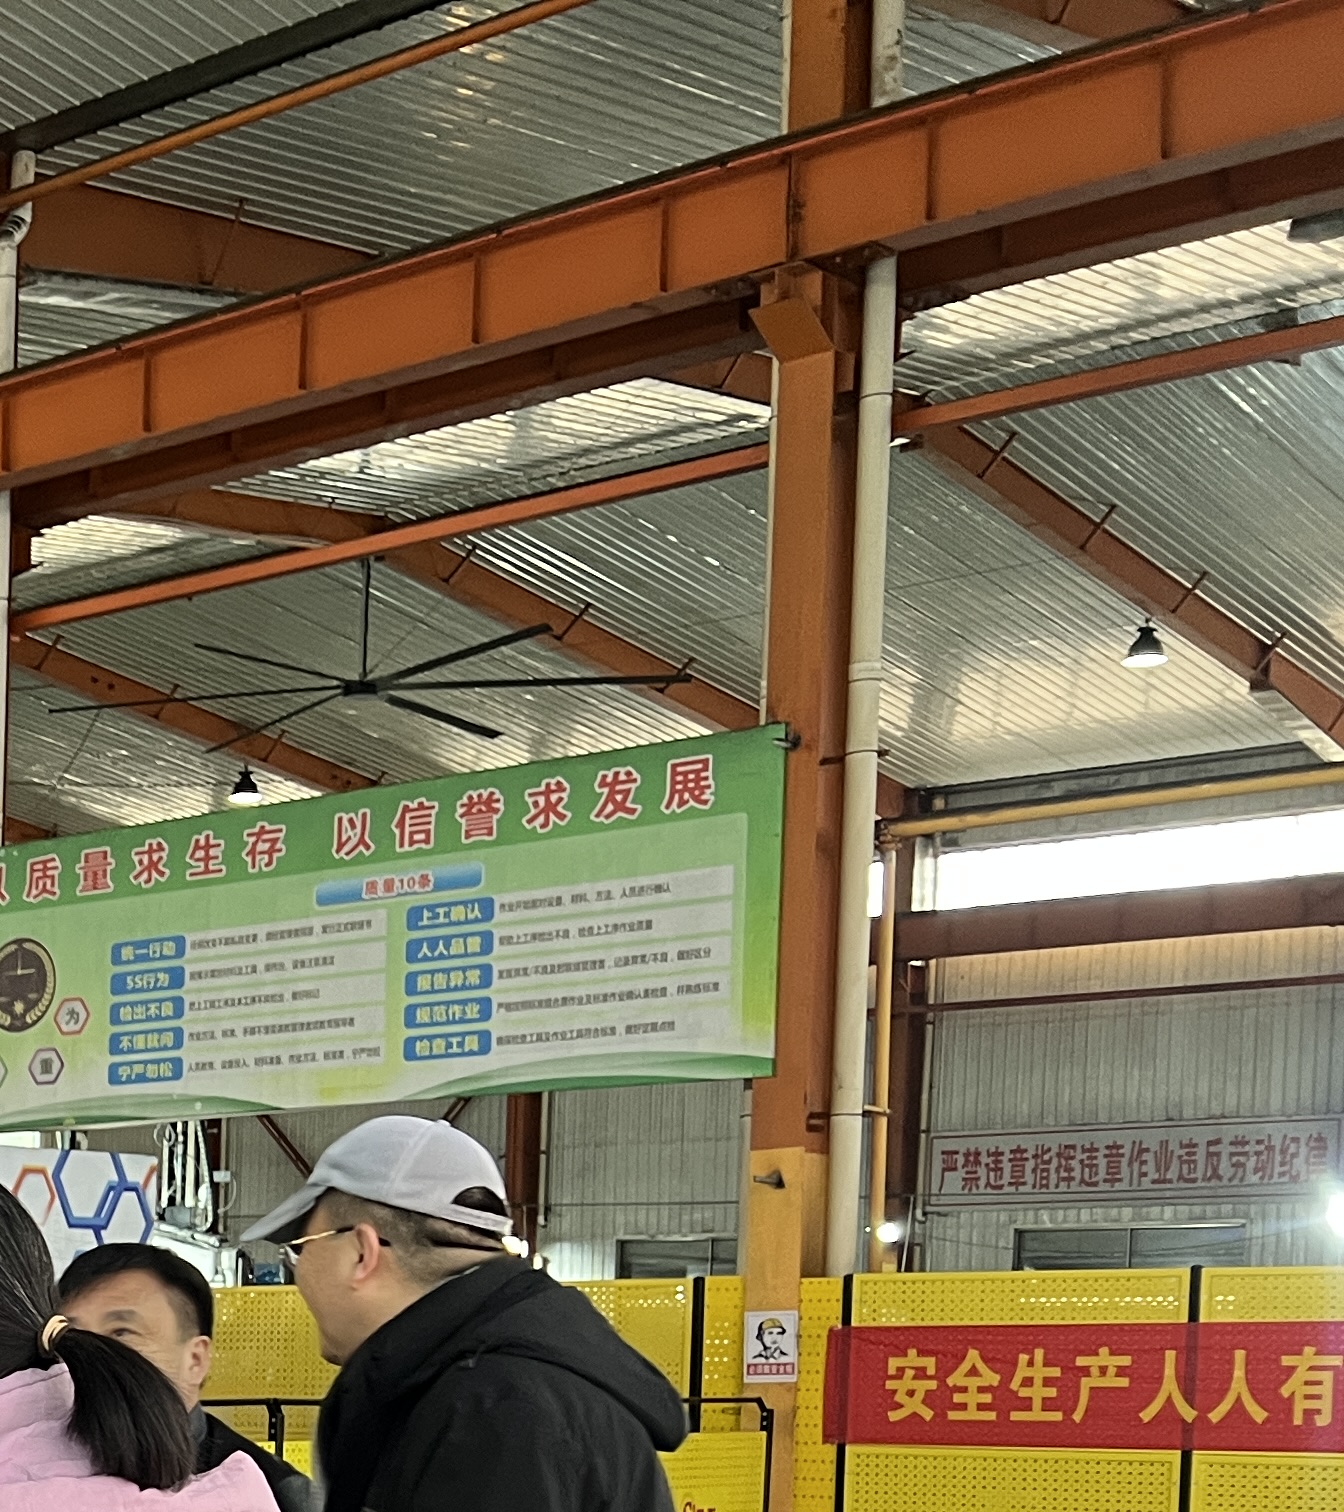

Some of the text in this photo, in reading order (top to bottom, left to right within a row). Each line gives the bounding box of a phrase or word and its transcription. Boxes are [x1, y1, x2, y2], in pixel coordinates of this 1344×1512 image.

[332, 754, 716, 860] 以信誉求发展
[416, 1002, 480, 1024] 规范作业
[884, 1345, 1344, 1426] 安全生产人人有
